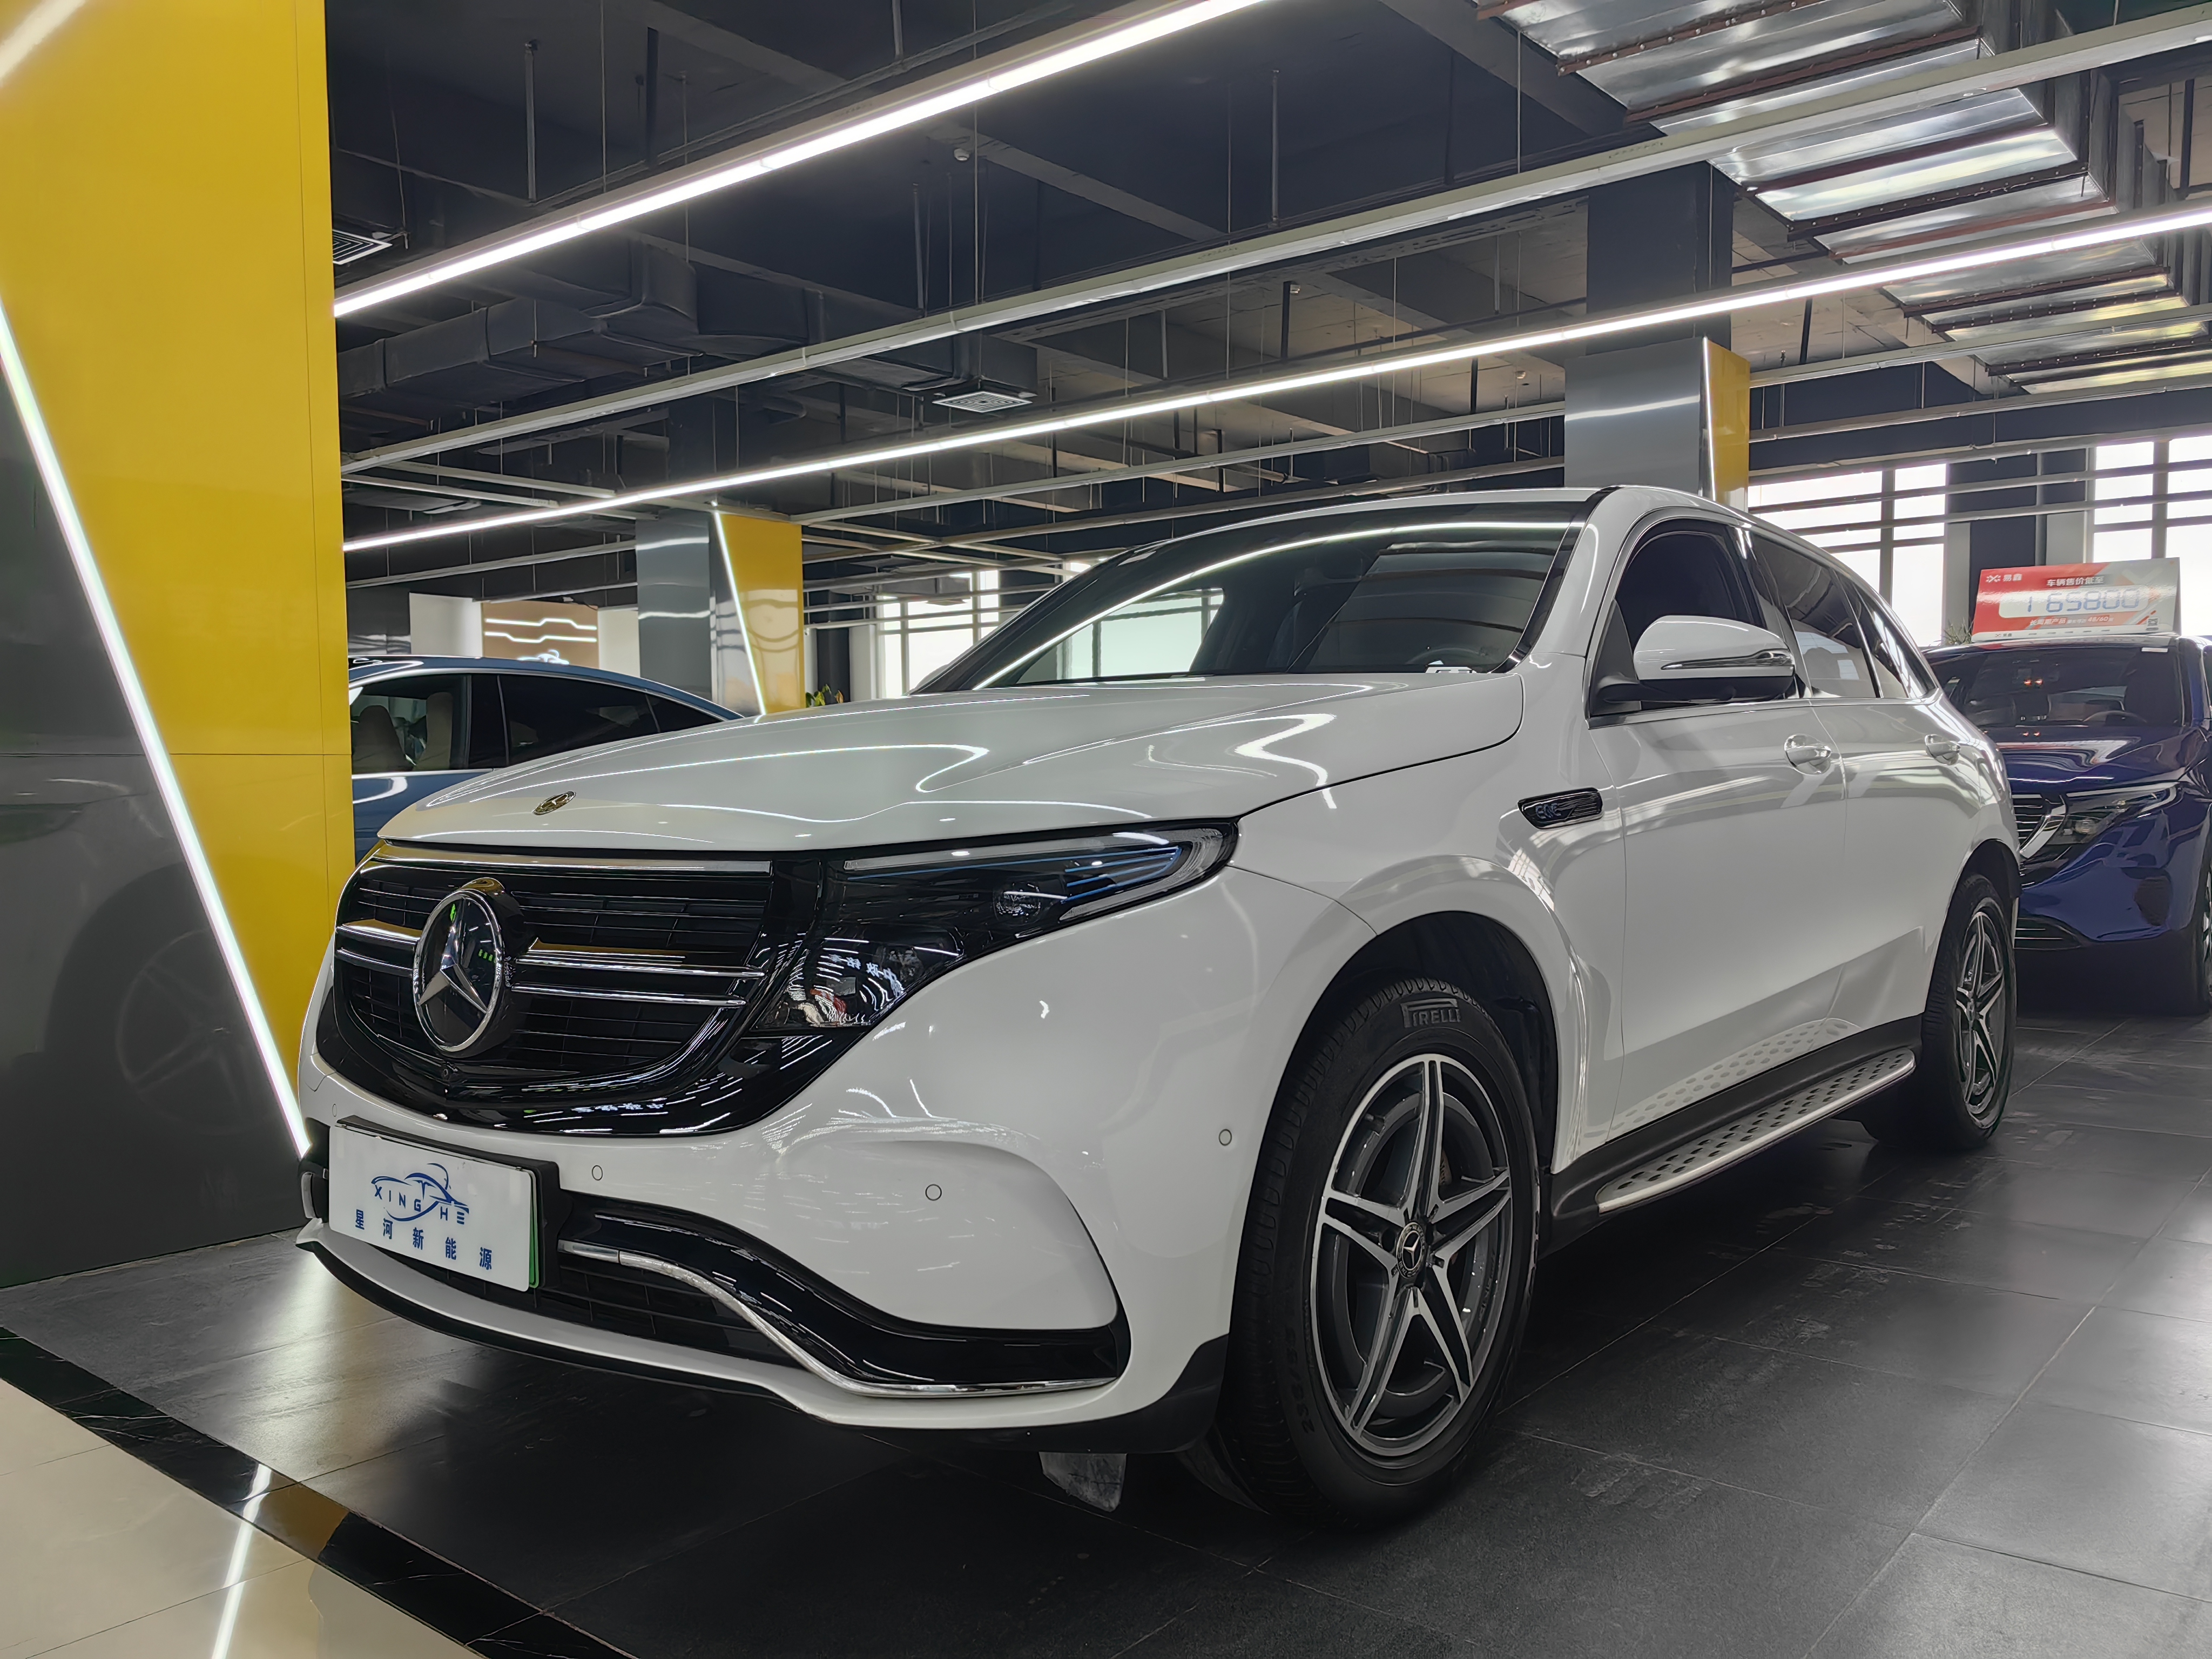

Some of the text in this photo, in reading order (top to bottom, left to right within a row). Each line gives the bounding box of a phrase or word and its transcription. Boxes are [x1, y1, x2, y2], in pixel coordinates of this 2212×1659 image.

[2002, 574, 2022, 582] 易鑫
[2047, 576, 2104, 586] 车辆售价低至
[1400, 998, 1461, 1028] PIRELLI
[355, 1209, 493, 1271] 星河新能源
